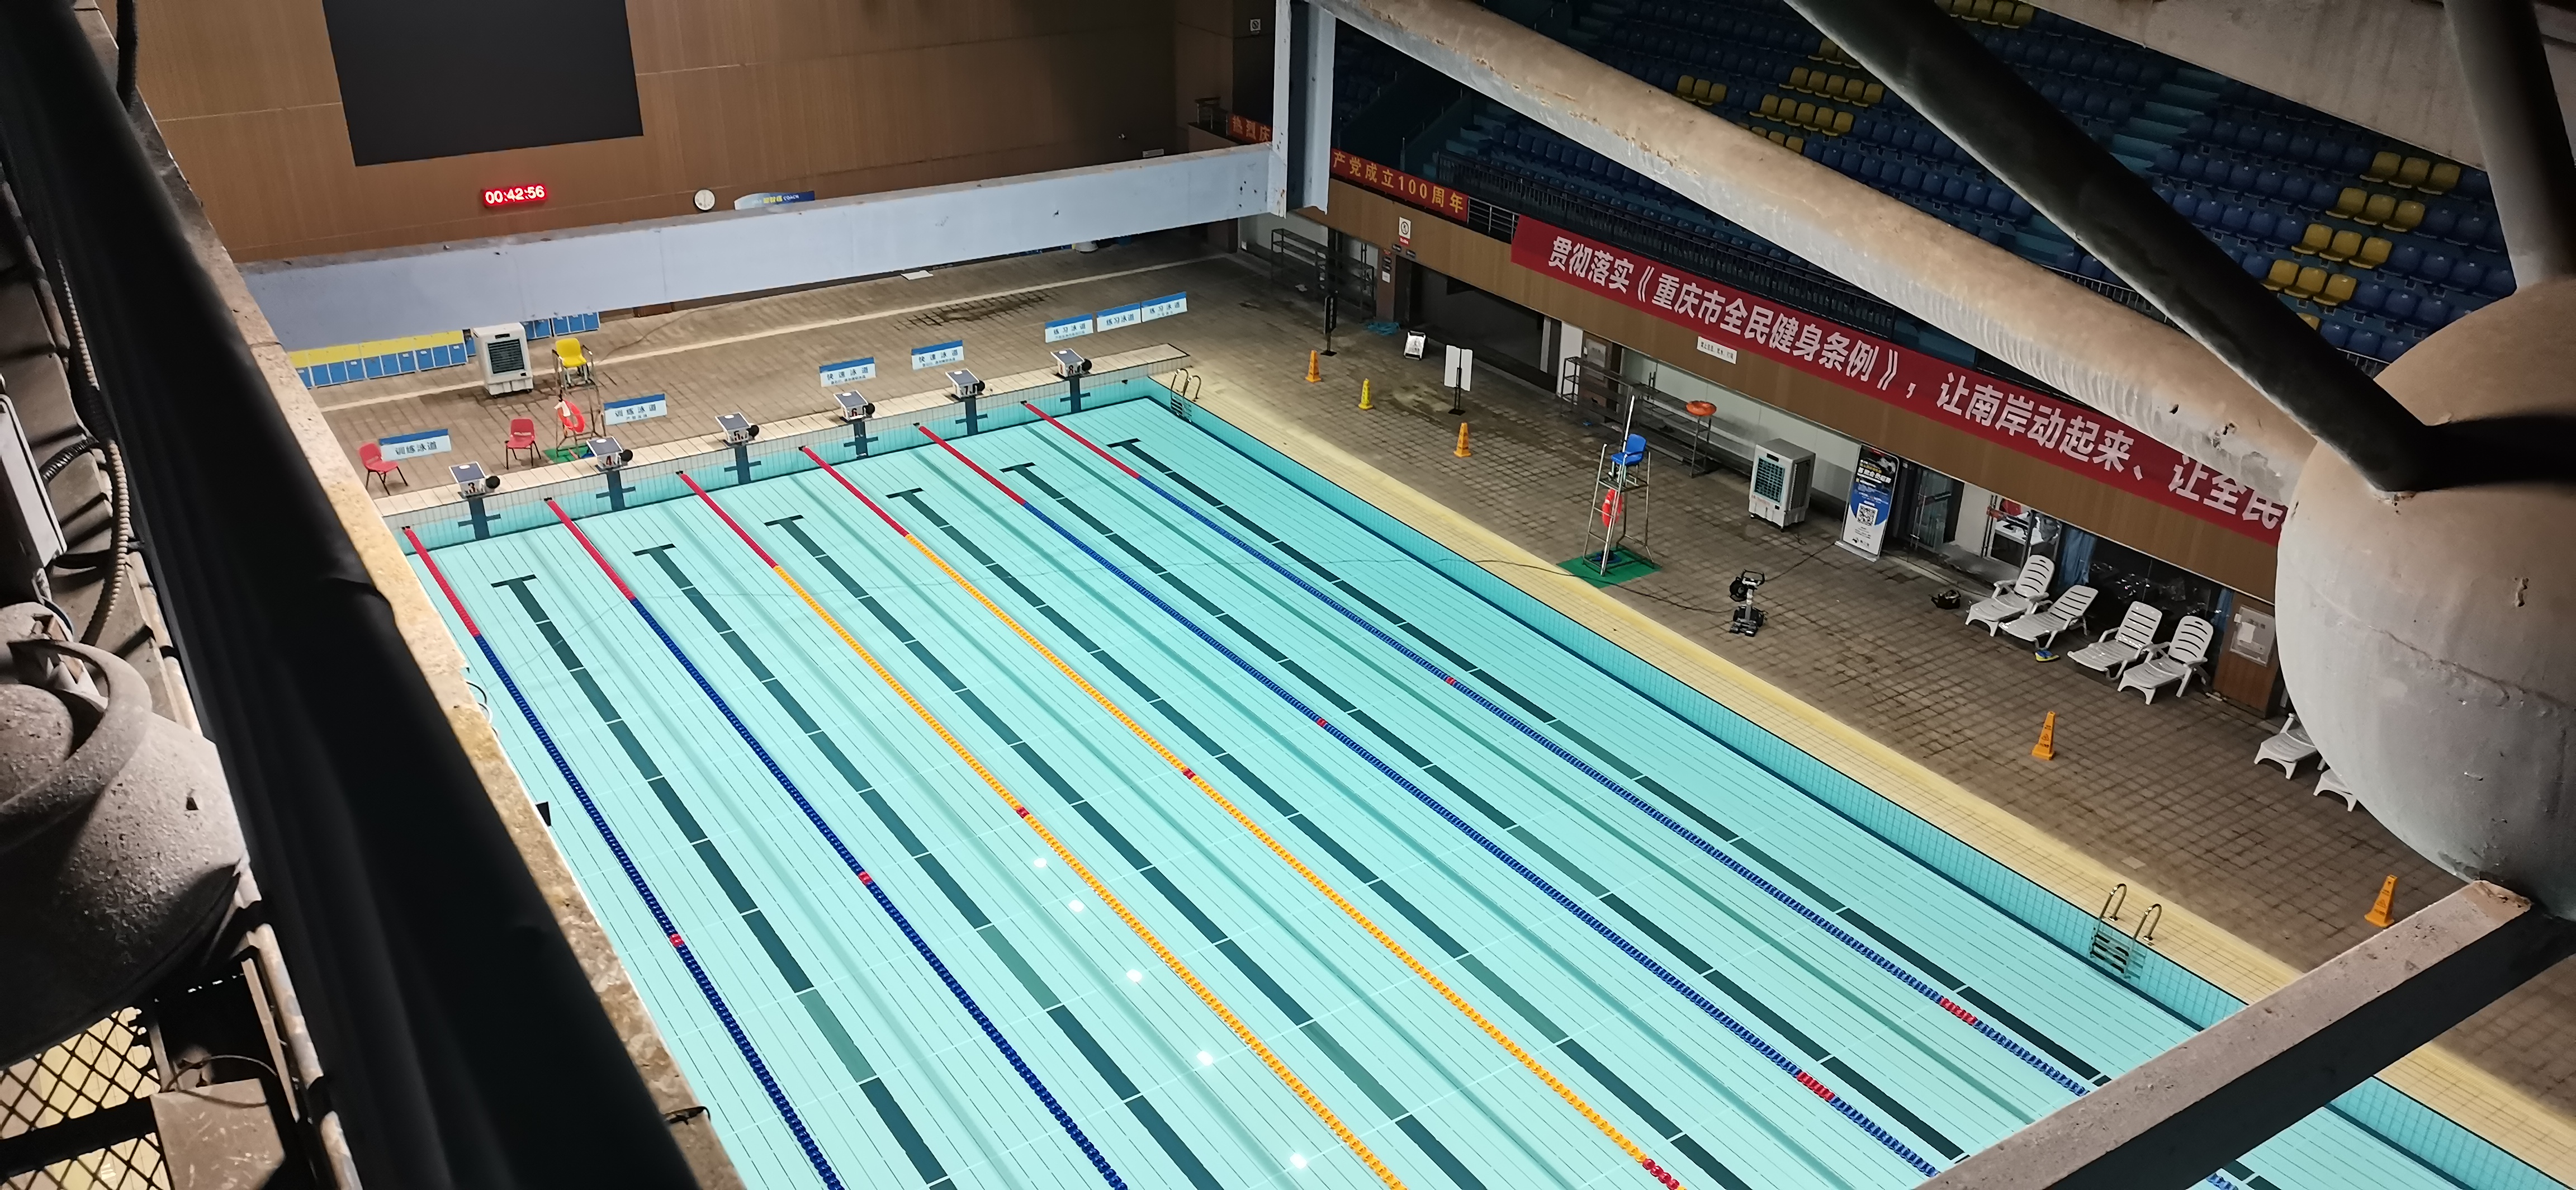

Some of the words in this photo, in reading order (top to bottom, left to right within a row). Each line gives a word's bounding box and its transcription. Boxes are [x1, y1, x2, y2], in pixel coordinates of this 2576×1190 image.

[1333, 151, 1464, 213] 产党成立100周年
[485, 185, 545, 204] 00:42:56
[1106, 313, 1134, 326] 练习泳道
[1069, 365, 1074, 375] 8
[963, 385, 968, 395] 7
[395, 441, 437, 455] 训练泳道
[605, 455, 612, 465] 4
